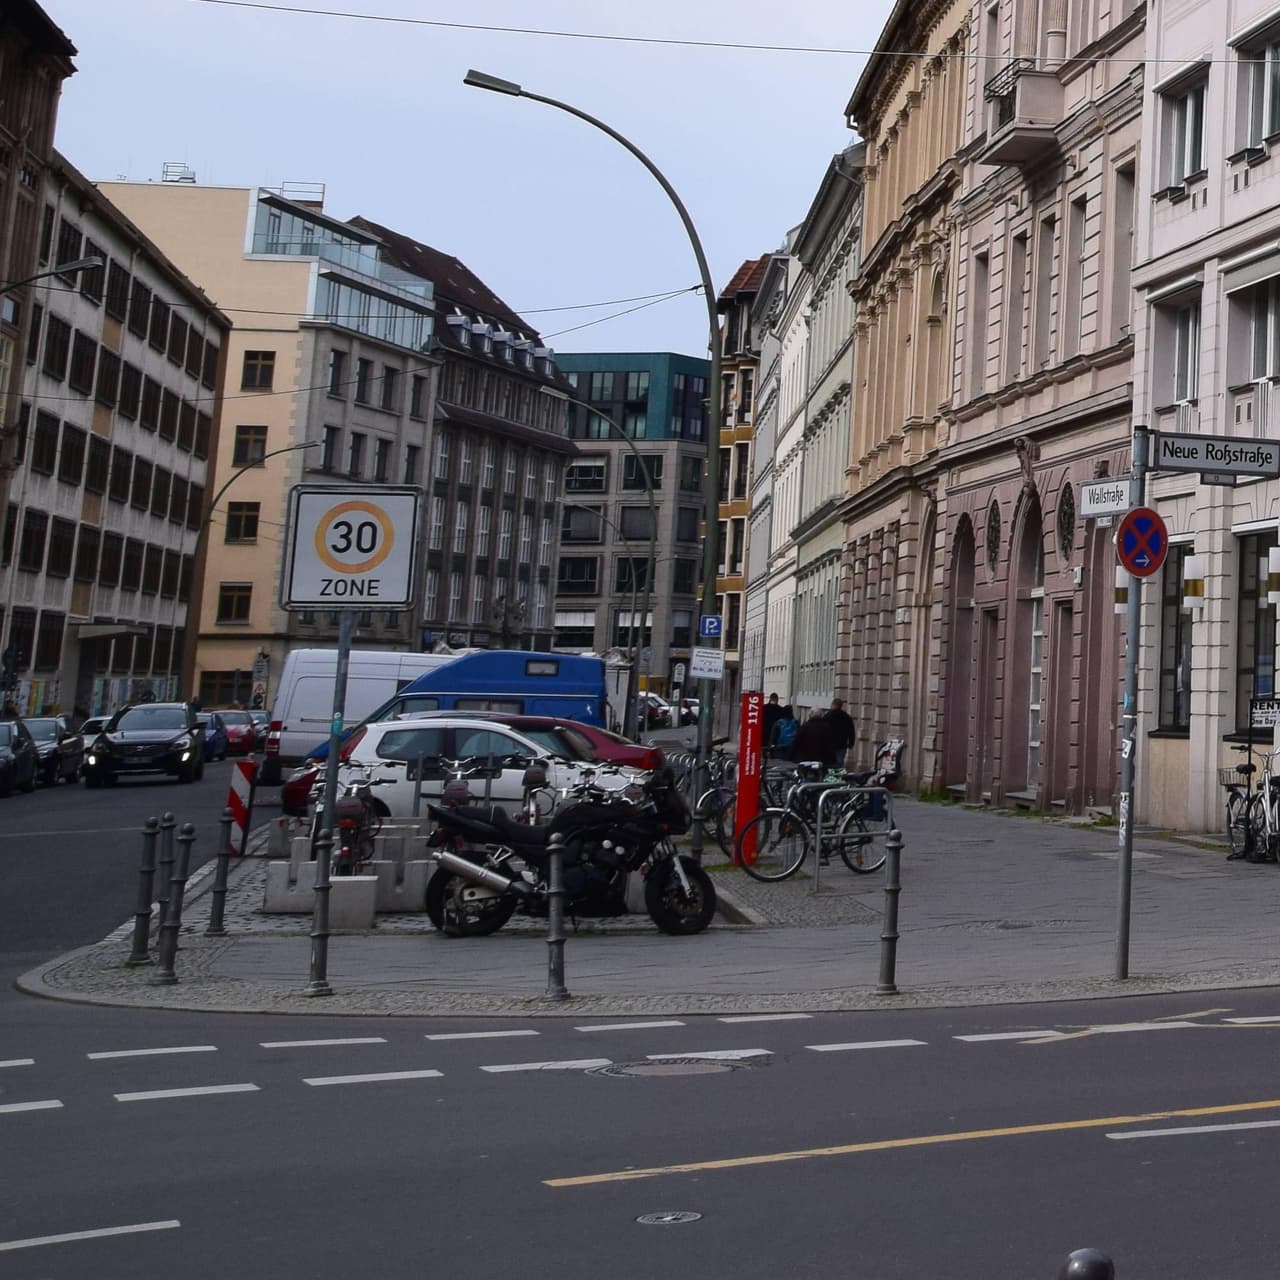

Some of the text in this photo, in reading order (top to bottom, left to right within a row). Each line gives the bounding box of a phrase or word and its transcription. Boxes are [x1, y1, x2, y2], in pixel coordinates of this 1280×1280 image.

[1163, 440, 1273, 467] Neue Roßstraße
[1088, 485, 1124, 506] Wallstraße
[331, 520, 378, 554] 30
[319, 578, 381, 596] ZONE
[748, 696, 759, 725] 1176
